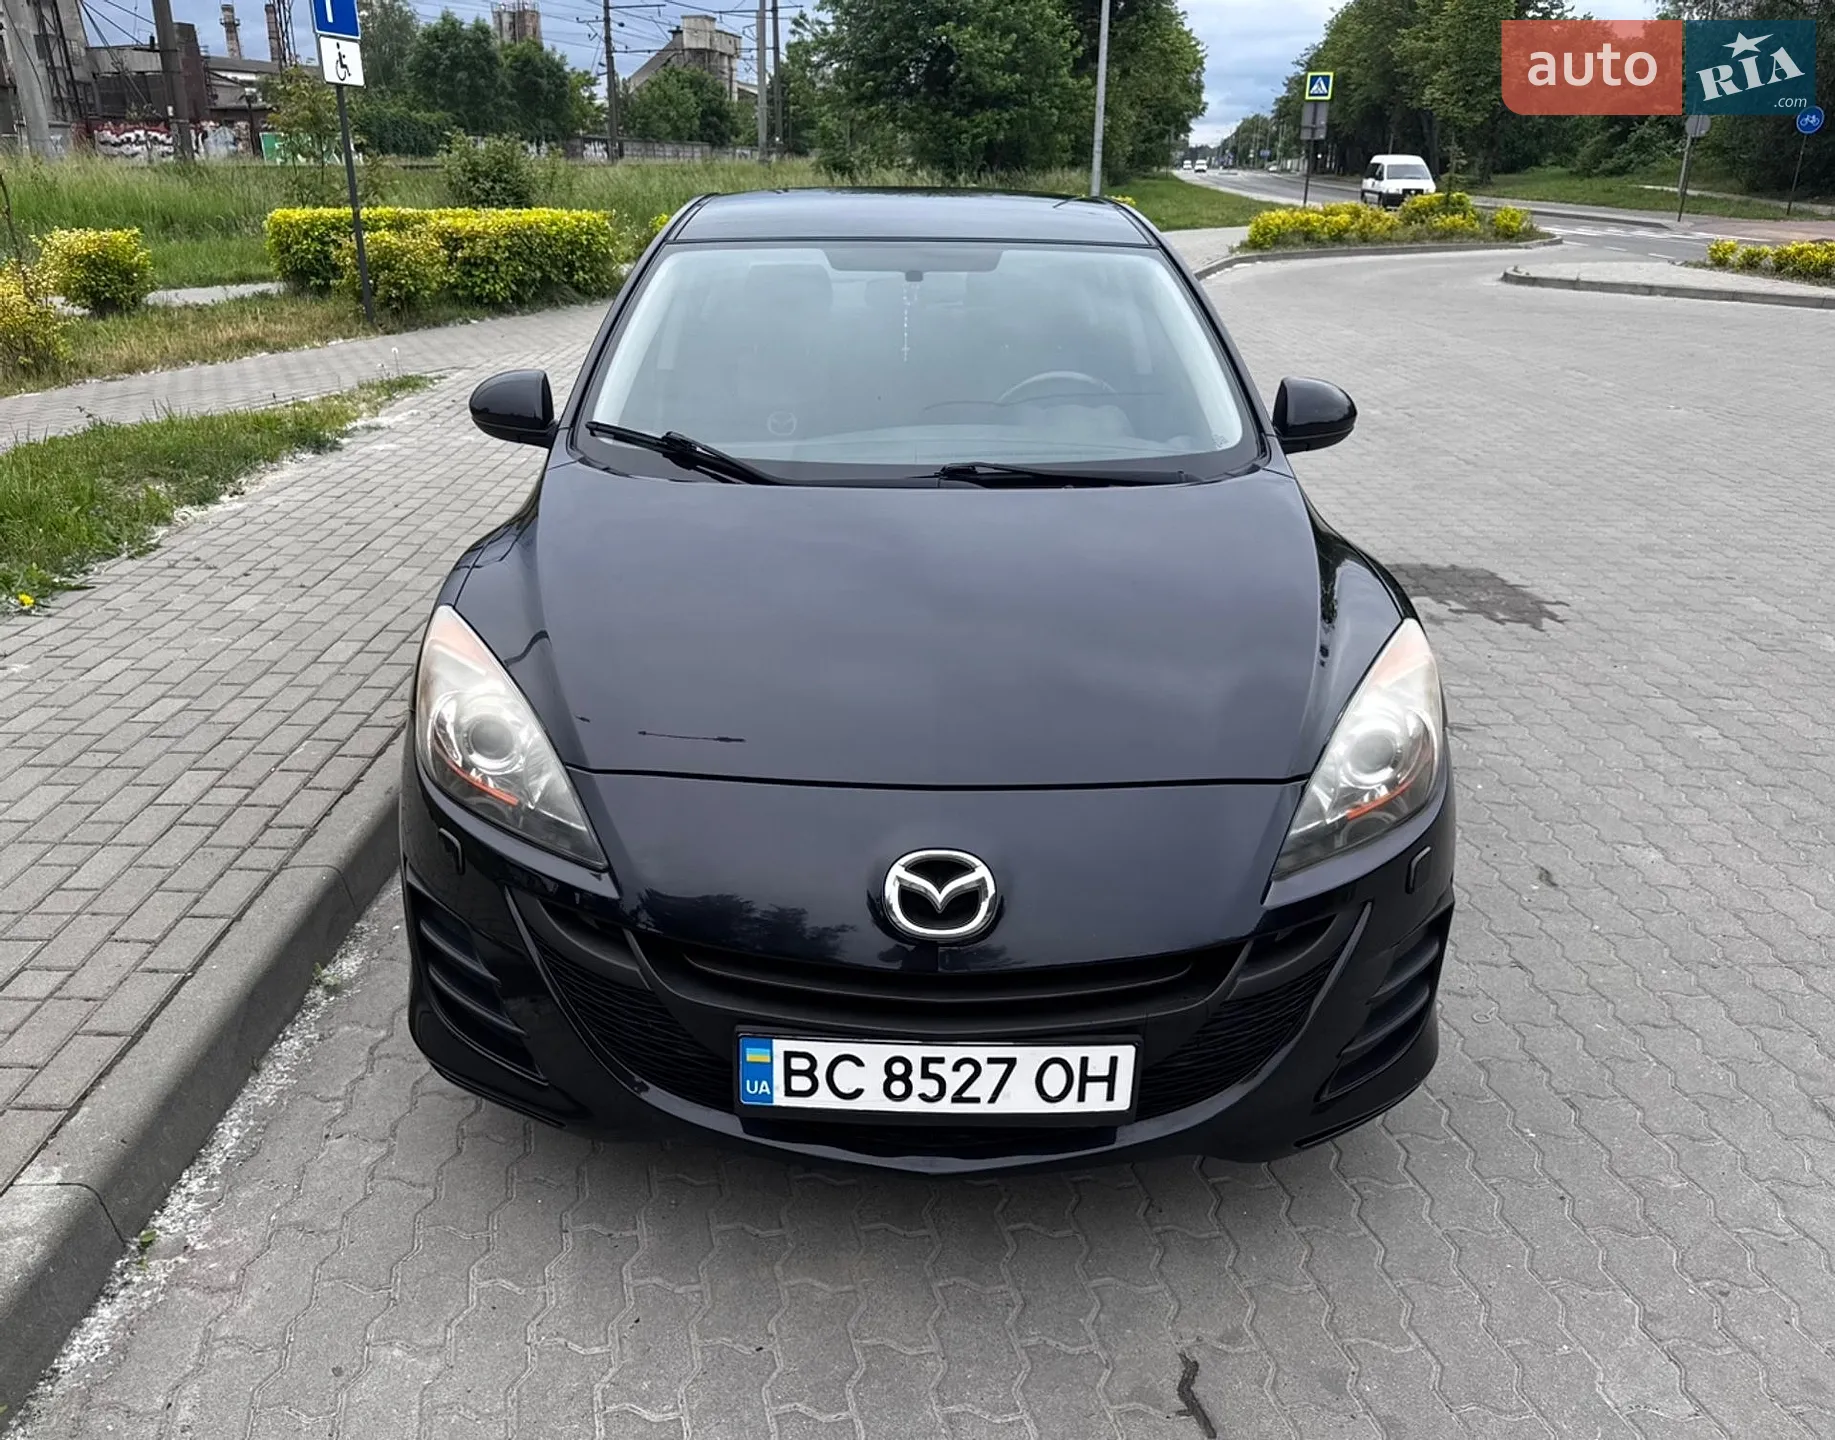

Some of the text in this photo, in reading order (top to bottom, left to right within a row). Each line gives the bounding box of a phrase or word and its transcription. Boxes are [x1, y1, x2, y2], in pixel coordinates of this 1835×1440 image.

[746, 1079, 771, 1095] UA
[782, 1050, 1119, 1104] BC 8527 OH
